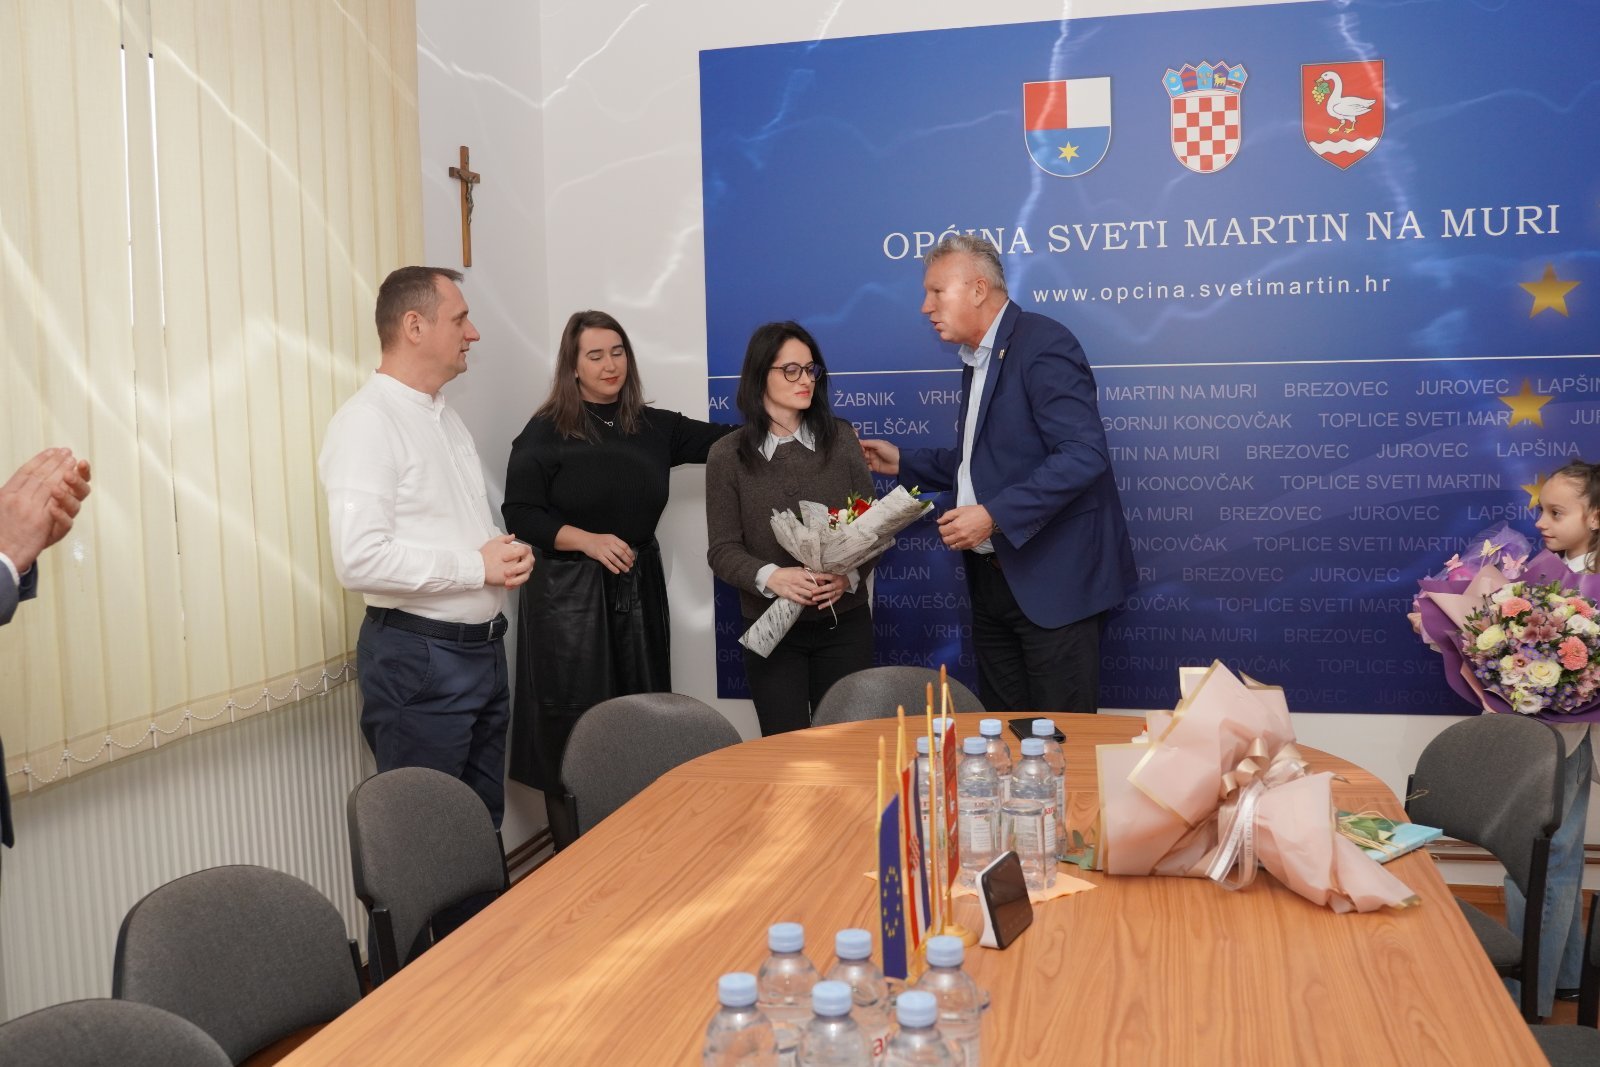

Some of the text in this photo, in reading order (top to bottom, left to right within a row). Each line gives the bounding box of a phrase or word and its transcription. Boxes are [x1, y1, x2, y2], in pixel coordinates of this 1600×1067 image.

[883, 204, 1560, 260] OPĆNA SVETI MARTIN NA MURI
[1033, 275, 1391, 304] www.opcina.svetimartin.hr
[833, 390, 895, 407] ŽABNIK
[1106, 385, 1174, 401] MARTIN
[1181, 385, 1205, 399] NA
[1210, 383, 1257, 398] MURI
[1284, 381, 1388, 398] BREZOVEC
[1416, 378, 1509, 395] JUROVEC
[851, 417, 930, 436] PELŠČAK
[1101, 416, 1167, 431] GORNJI
[1174, 411, 1292, 431] KONCOVČAK
[1318, 411, 1399, 429] TOPLICE
[1405, 410, 1460, 427] SVETI
[1144, 446, 1169, 461] NA
[1173, 446, 1219, 461] MURI
[1246, 444, 1349, 460] BREZOVEC
[1376, 442, 1468, 459] JUROVEC
[1497, 438, 1581, 457] LAPŠINA
[1137, 472, 1254, 491] KONCOVČAK
[1280, 475, 1360, 490] TOPLICE
[1366, 474, 1420, 490] SVETI
[1427, 473, 1500, 489] MARTIN
[1148, 507, 1193, 521] MURI
[1220, 506, 1322, 521] BREZOVEC
[1349, 505, 1440, 521] JUROVEC
[1468, 502, 1536, 520] LAPŠIN
[1253, 536, 1332, 551] TOPLICE
[1338, 536, 1391, 551] SVETI
[874, 566, 931, 580] VLJAN
[1182, 567, 1284, 582] BREZOVEC
[1310, 567, 1400, 582] JUROVEC
[872, 591, 972, 609] RKAVEŠČA
[1216, 597, 1294, 612] TOPLICE
[1300, 598, 1352, 613] SVETI
[1359, 598, 1412, 613] MART
[924, 624, 972, 638] VRHO
[1107, 627, 1387, 644] MARTIN NA MURI BREZOVEC
[1102, 655, 1168, 671] GORNJI
[1318, 658, 1396, 674] TOPLICE
